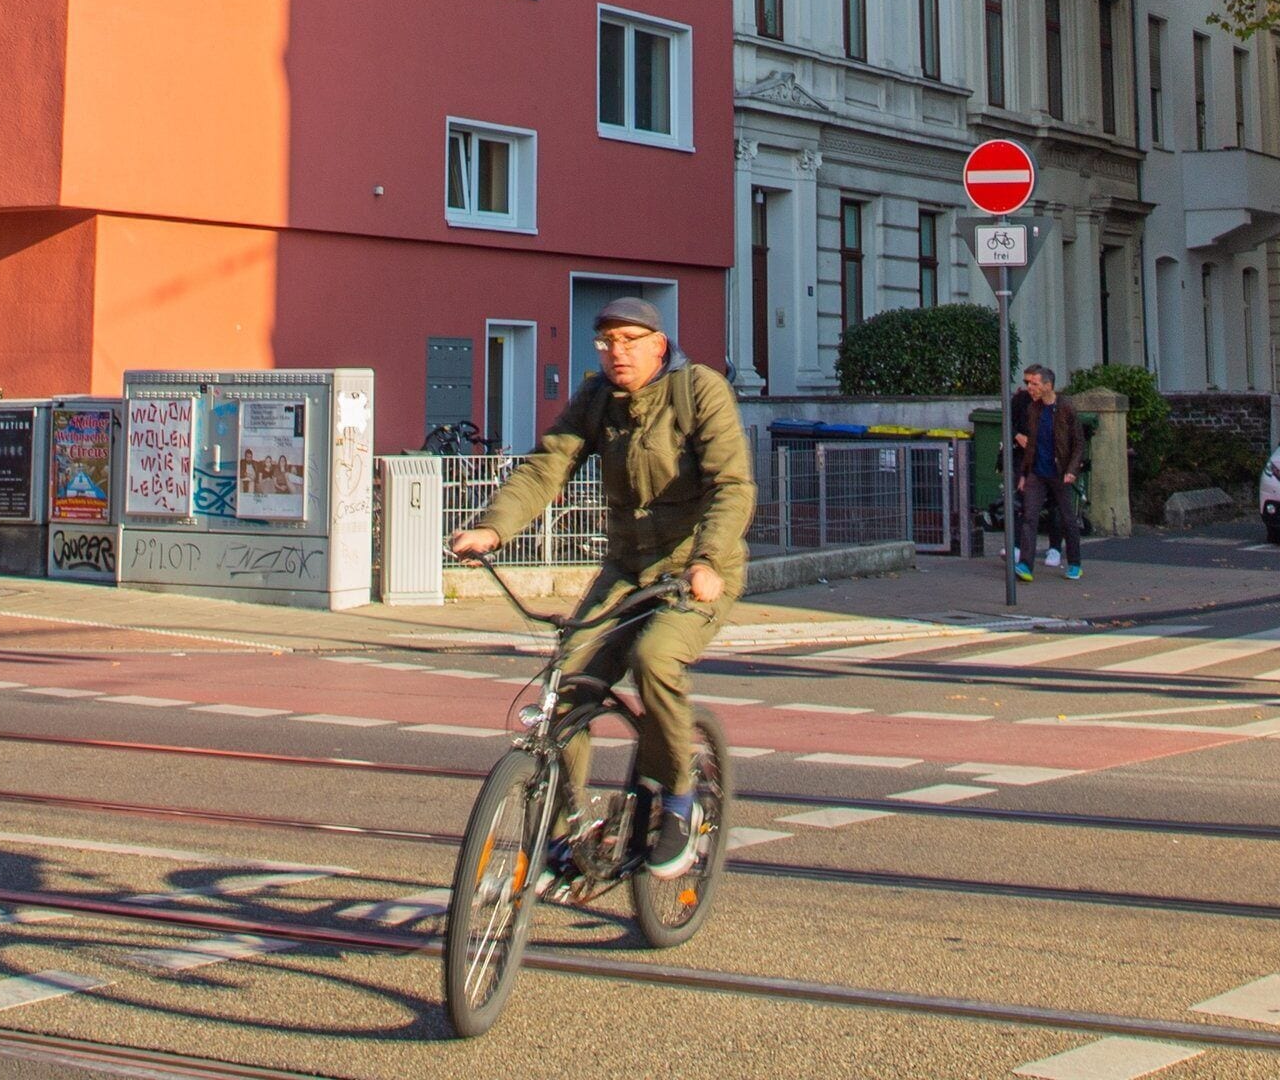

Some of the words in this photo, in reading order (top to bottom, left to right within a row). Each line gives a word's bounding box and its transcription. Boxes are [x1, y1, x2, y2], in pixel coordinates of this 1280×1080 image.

[993, 252, 1009, 260] frei
[131, 402, 191, 425] WOVON
[0, 421, 30, 430] NATION
[130, 429, 190, 450] WOLLEN
[69, 445, 109, 459] Circus
[141, 452, 174, 472] WIR
[130, 473, 187, 498] LEBEN
